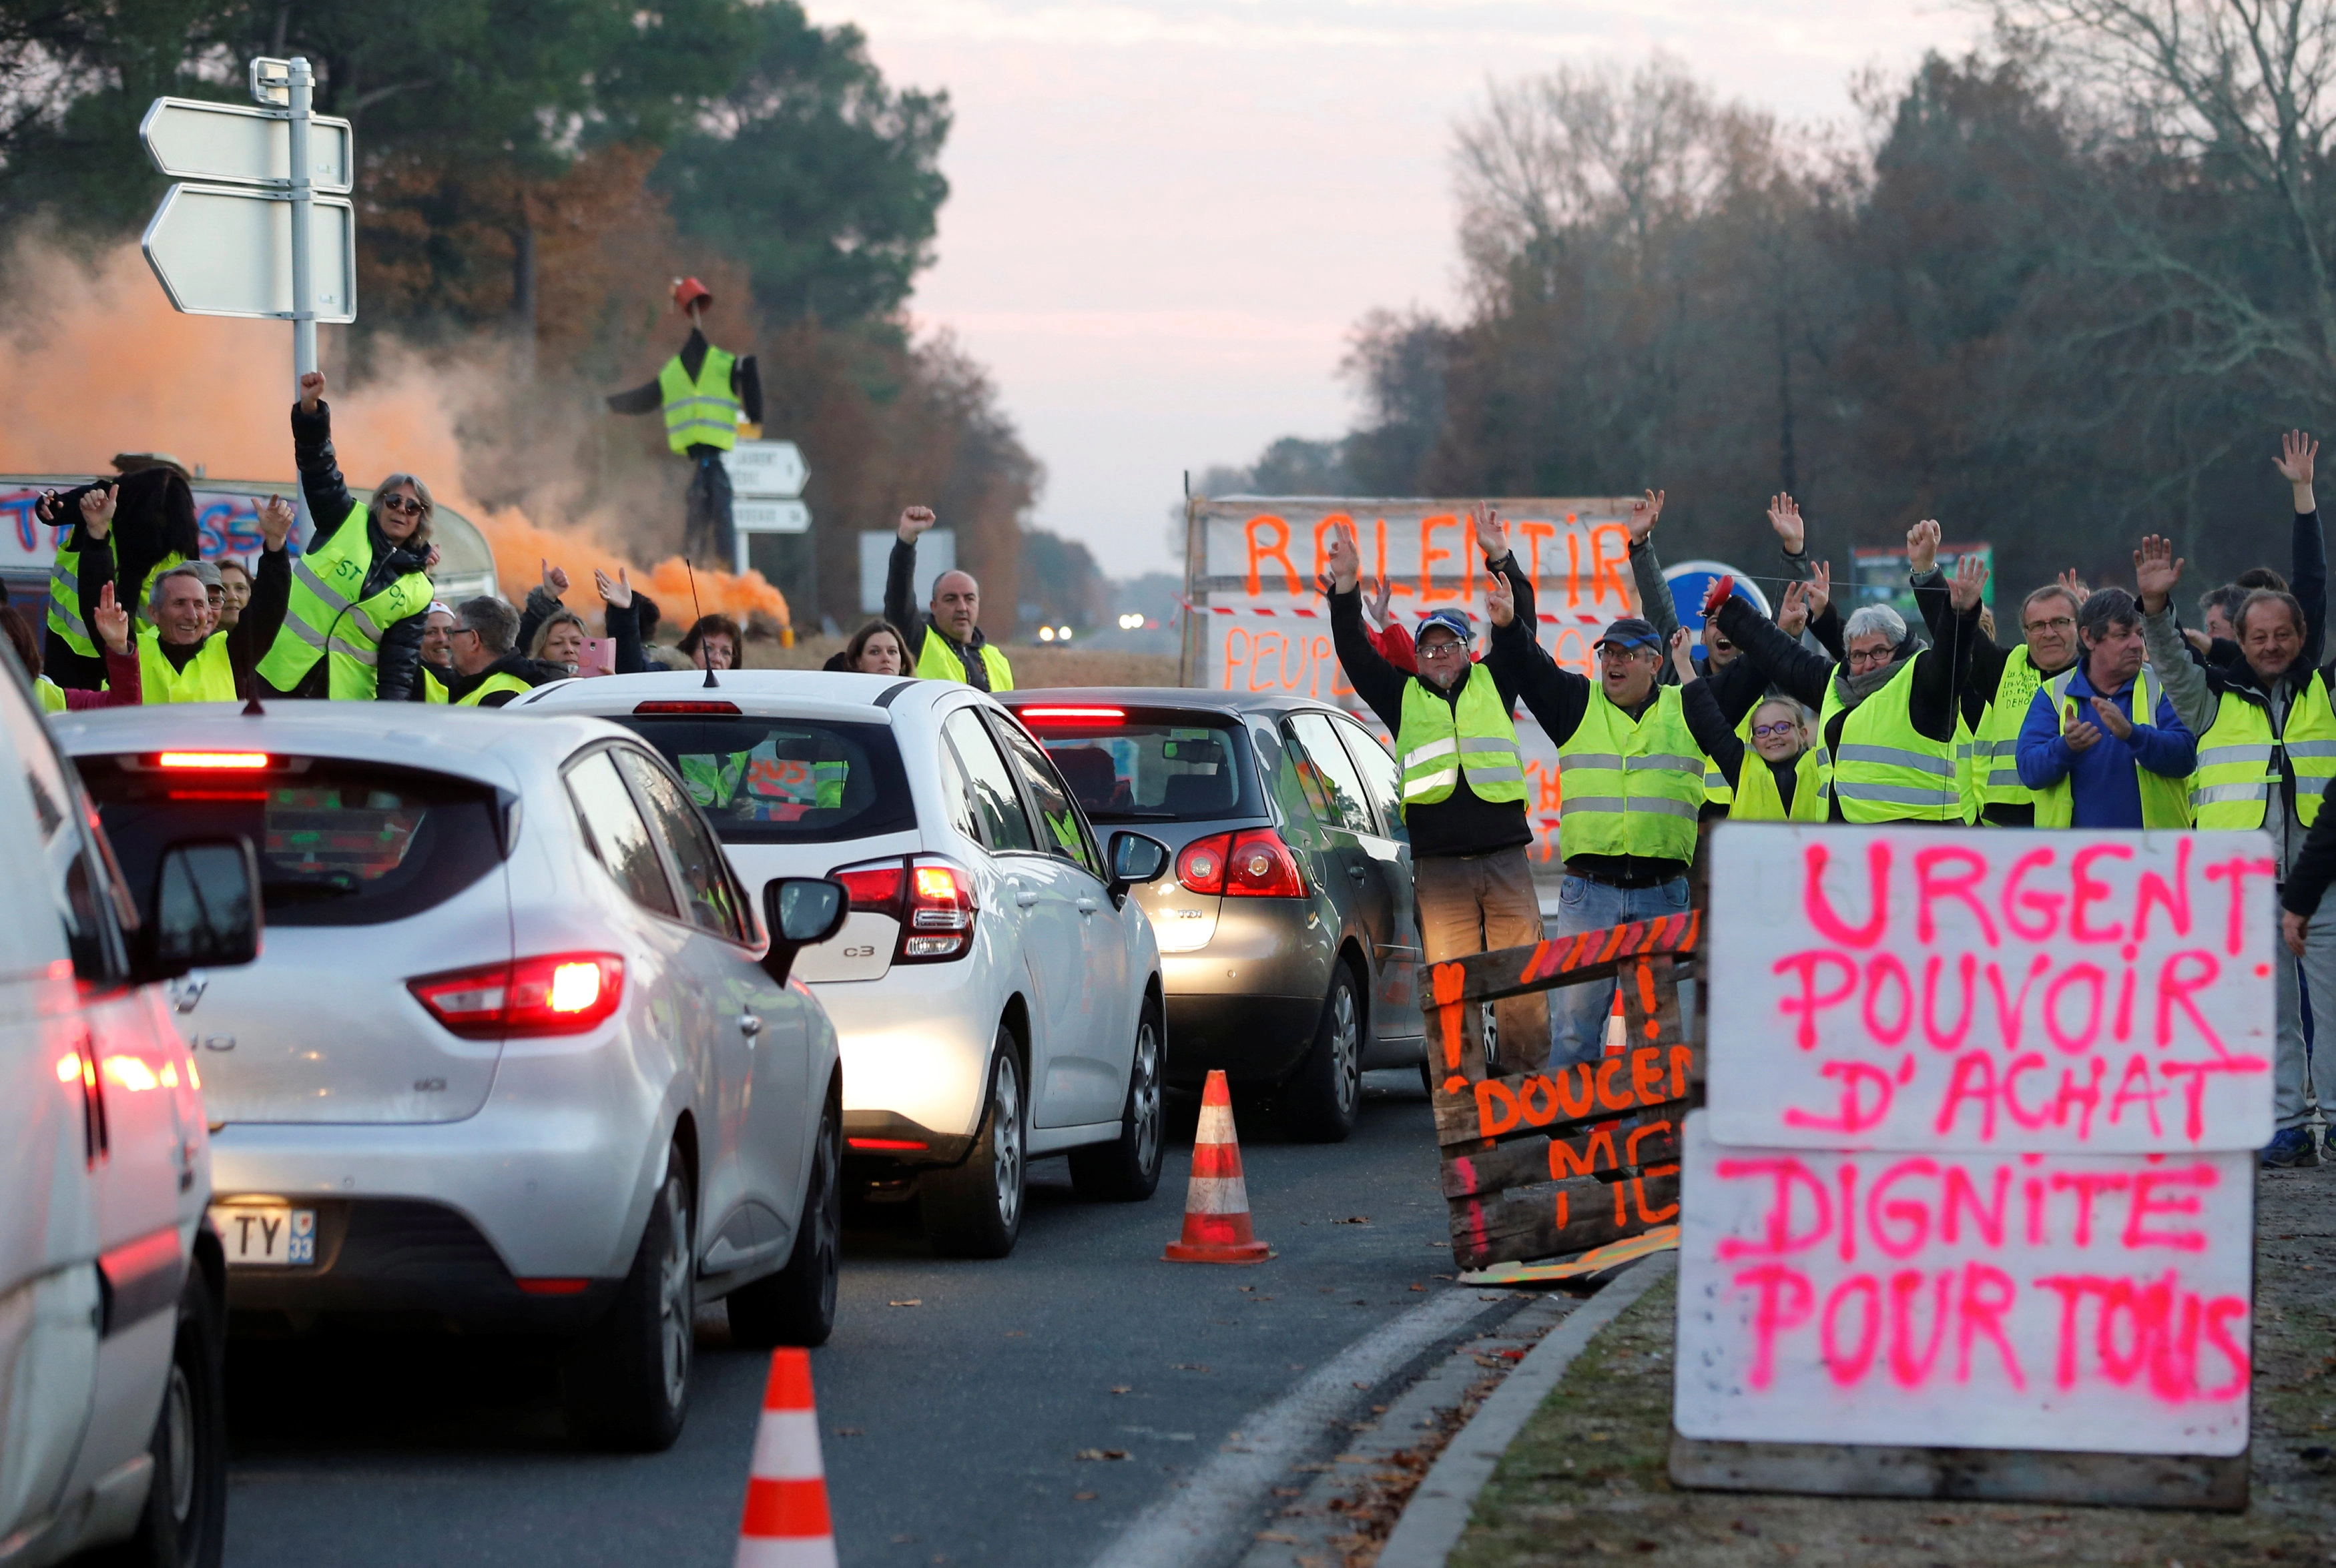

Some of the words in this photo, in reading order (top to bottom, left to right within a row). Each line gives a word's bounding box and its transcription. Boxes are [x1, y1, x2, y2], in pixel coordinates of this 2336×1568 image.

[1224, 627, 1356, 697] PEUPL
[2006, 697, 2030, 709] DEHO
[1177, 909, 1203, 919] TDI
[1803, 837, 2275, 957] URGENT
[843, 945, 875, 957] C3
[1783, 1050, 2270, 1142] D'ACHAT
[290, 1236, 313, 1260] 33
[1731, 1258, 2025, 1392] POUR
[2032, 1266, 2251, 1408] TOUS
